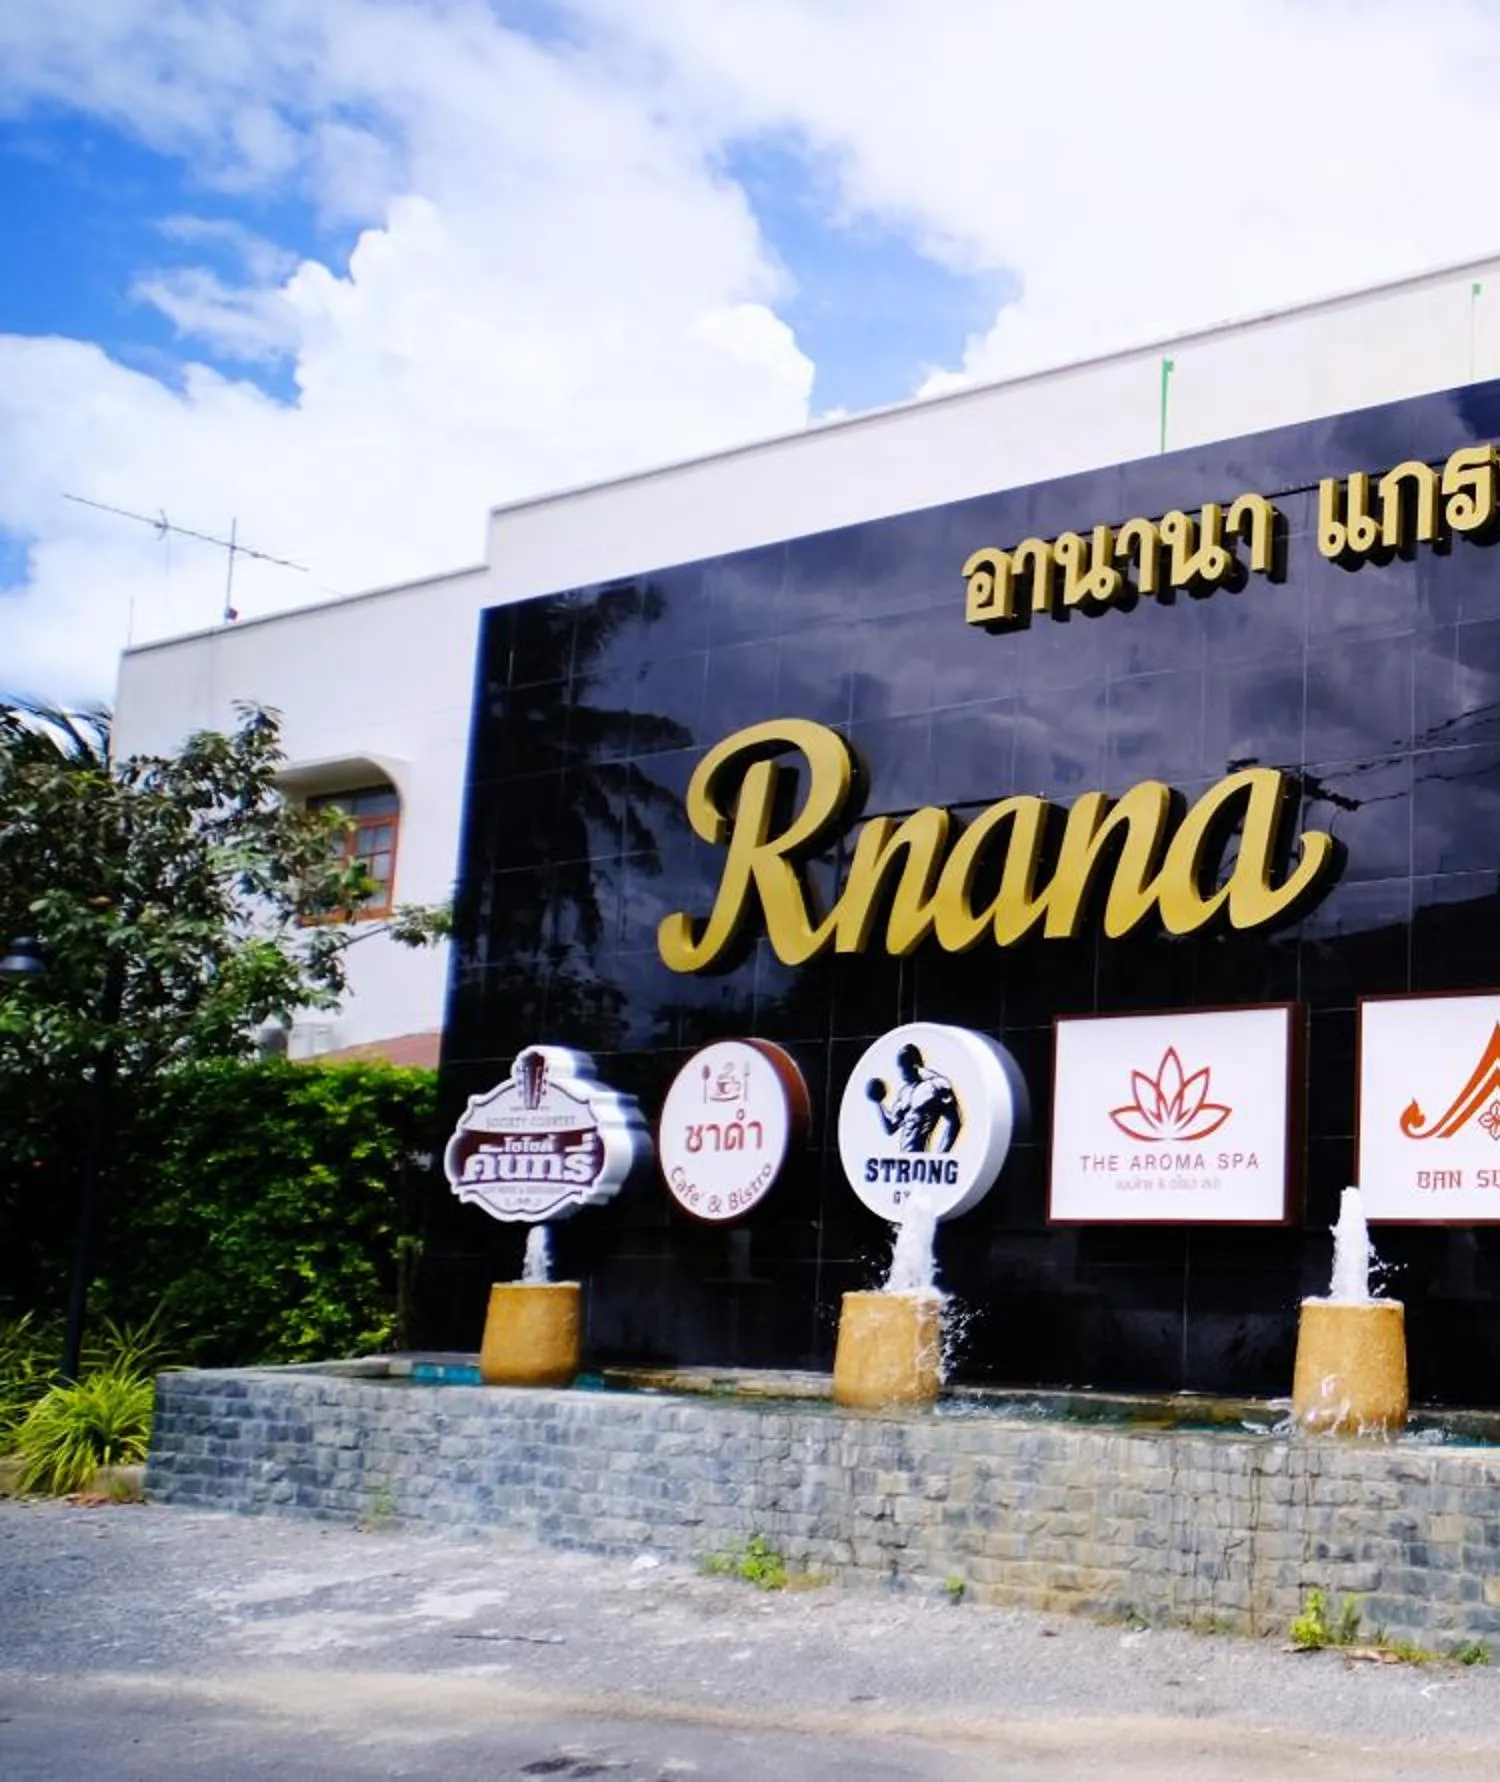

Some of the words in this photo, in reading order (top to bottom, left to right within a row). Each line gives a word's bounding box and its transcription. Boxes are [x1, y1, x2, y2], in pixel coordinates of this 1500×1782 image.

[962, 493, 1278, 626] อานานา
[685, 1108, 763, 1153] ชาดำ
[865, 1158, 959, 1184] STRONG
[1080, 1155, 1119, 1171] THE
[1130, 1153, 1206, 1171] AROMA
[1217, 1152, 1260, 1170] SPA
[707, 1194, 722, 1213] &
[729, 1163, 772, 1211] Bistro
[1417, 1170, 1463, 1191] BAN
